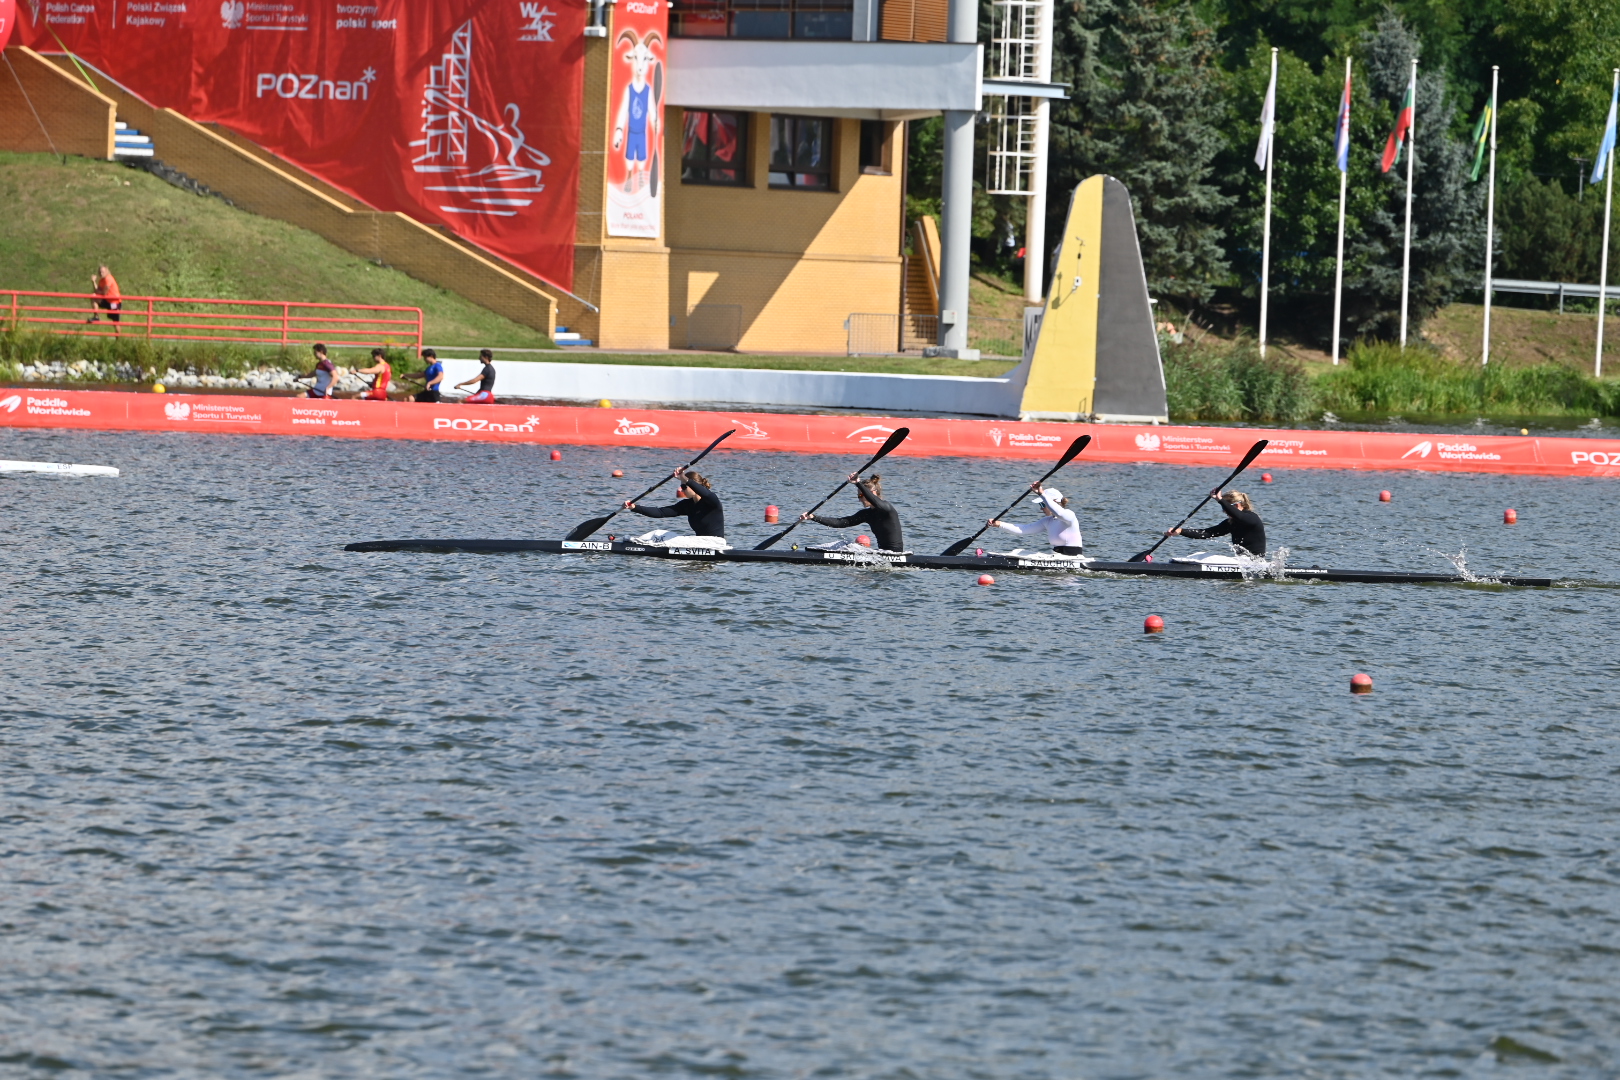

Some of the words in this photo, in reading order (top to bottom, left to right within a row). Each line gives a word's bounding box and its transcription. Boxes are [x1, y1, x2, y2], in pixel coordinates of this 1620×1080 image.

[46, 2, 69, 12] Polish
[71, 3, 95, 12] Canoe
[127, 2, 152, 12] Polski
[246, 2, 294, 11] Ministerstwo
[337, 4, 378, 16] tworzymy
[46, 13, 86, 24] Federation
[126, 15, 165, 27] Kajakowy
[246, 13, 270, 22] Sportu
[277, 13, 308, 23] Turystyki
[336, 18, 367, 29] polski
[371, 19, 397, 29] sport
[27, 396, 68, 407] Paddle
[27, 406, 91, 416] Worldwide
[193, 403, 245, 413] Ministerstwo
[292, 407, 338, 418] tworzymy
[193, 412, 220, 420] Sportu
[225, 413, 262, 421] Turystyki
[1008, 433, 1034, 441] Polish
[1035, 434, 1062, 442] Canoe
[1162, 435, 1213, 444] Ministerstwo
[1437, 442, 1477, 452] Paddle
[1438, 451, 1501, 461] Worldwide
[580, 542, 610, 550] AIN-B
